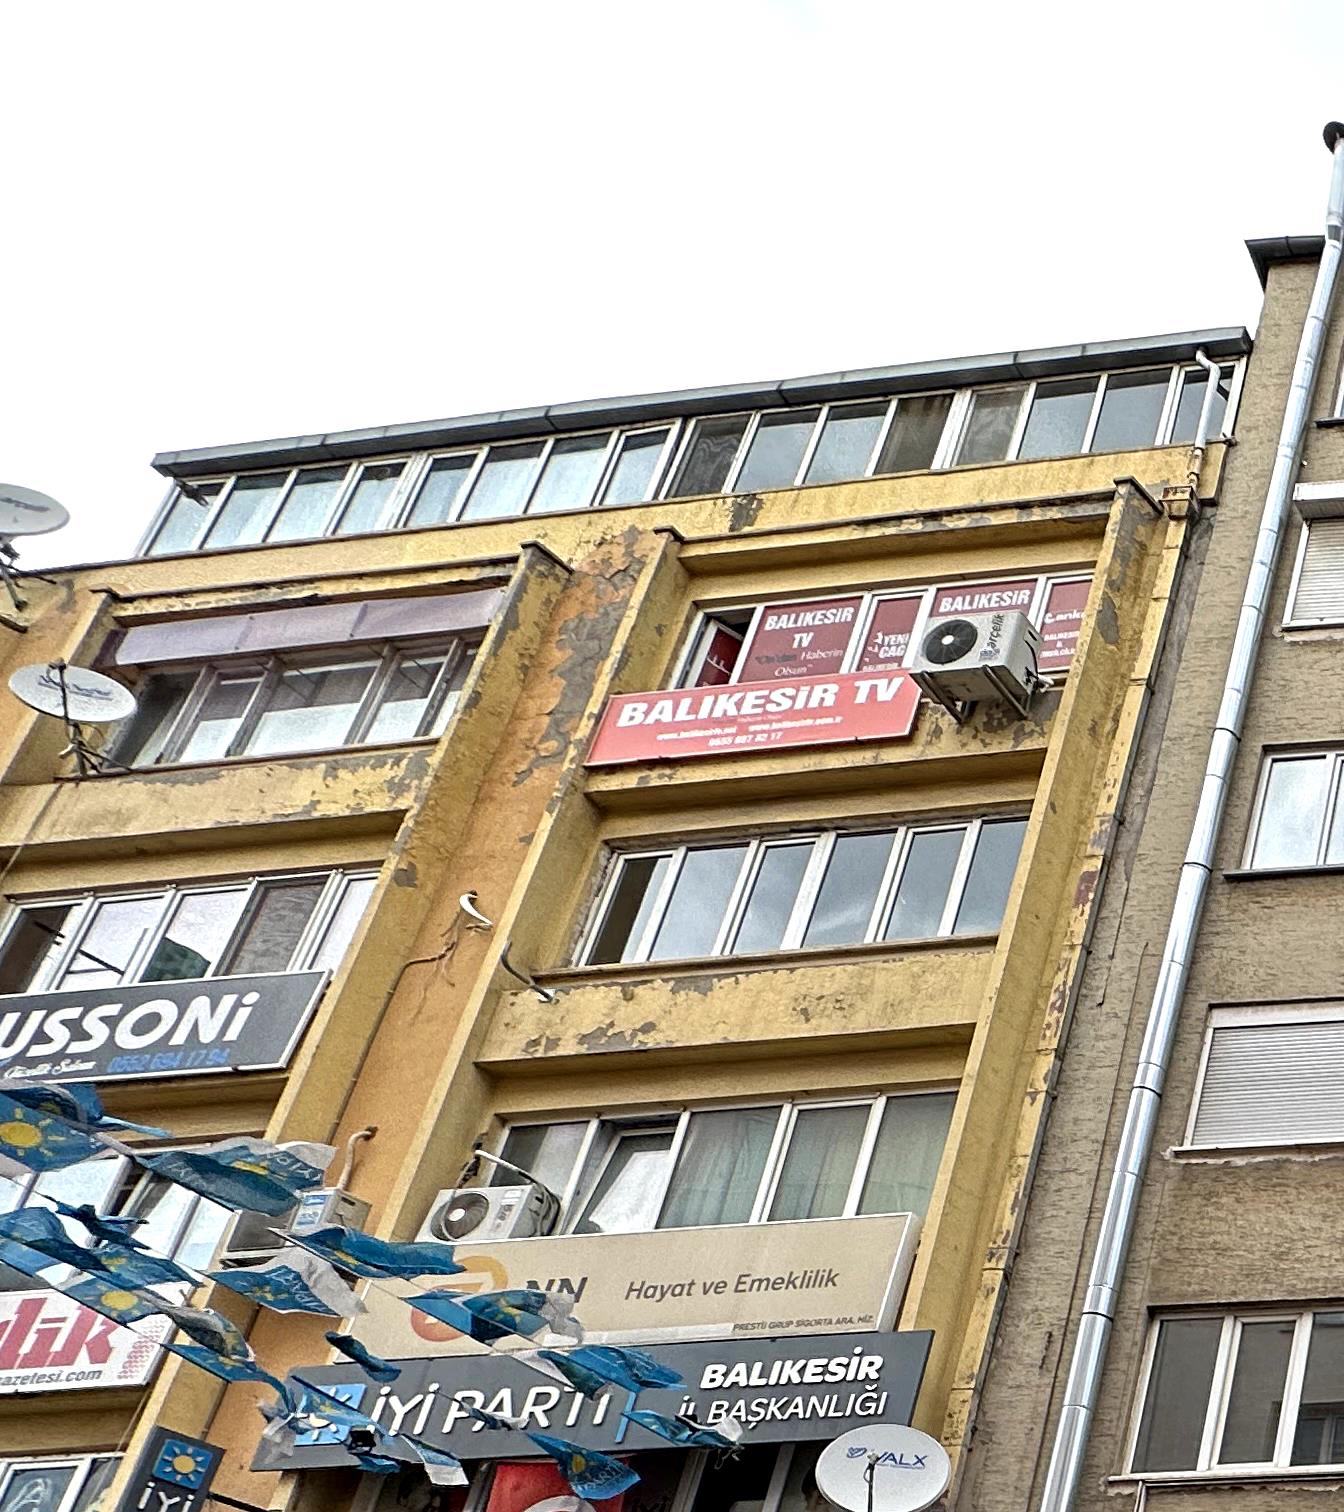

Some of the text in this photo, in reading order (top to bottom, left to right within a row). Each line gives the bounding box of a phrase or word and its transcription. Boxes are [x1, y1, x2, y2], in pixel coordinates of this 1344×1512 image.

[792, 632, 815, 649] TV
[853, 676, 905, 704] TV
[624, 1278, 698, 1302] Hayat
[702, 1276, 728, 1297] ve
[733, 1267, 840, 1294] Emeklilik
[0, 1297, 121, 1370] lik
[0, 1369, 103, 1387] azetesi.com
[699, 1346, 884, 1389] BALIKESİR
[365, 1381, 441, 1438] İYİ
[705, 1383, 889, 1430] BAŞKANLIĞI
